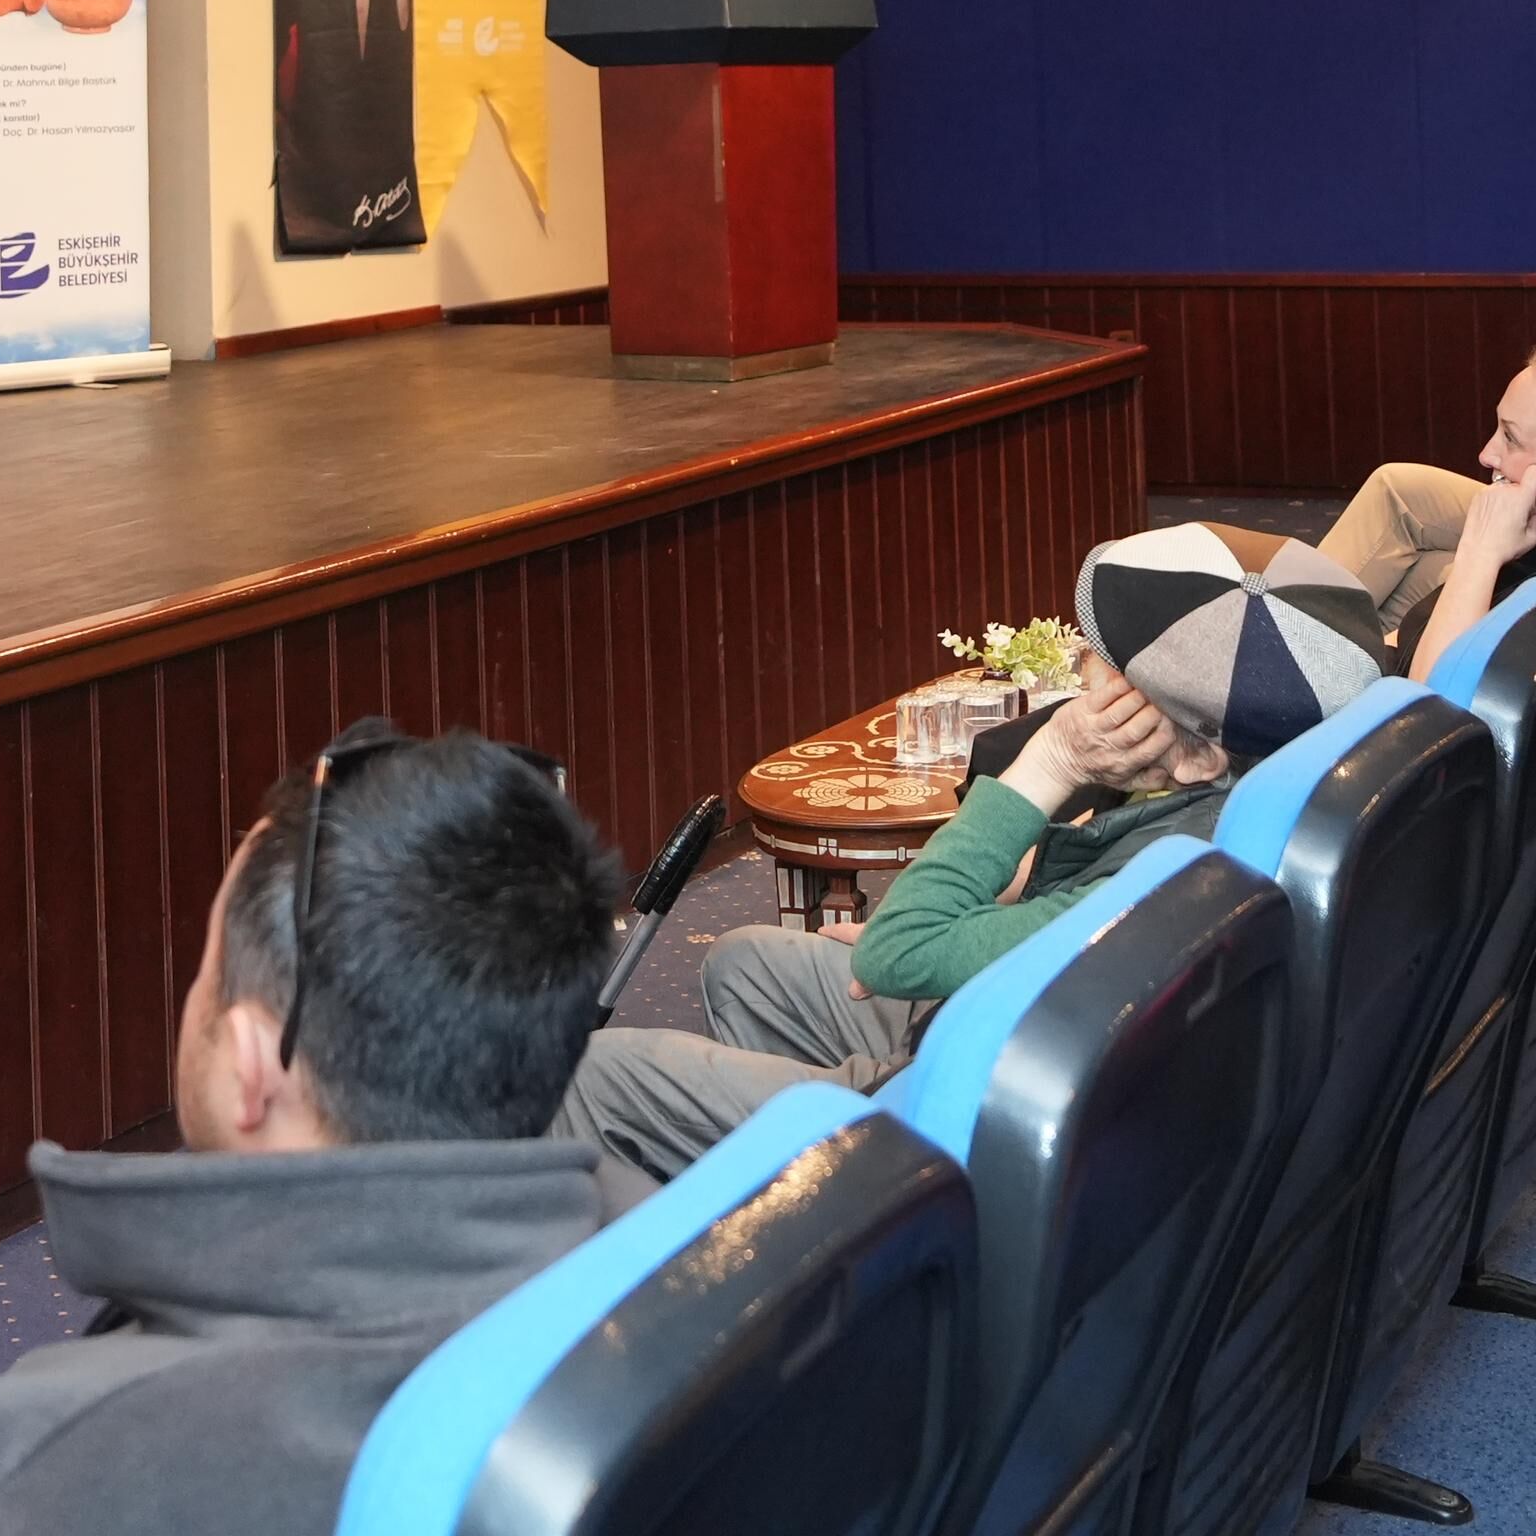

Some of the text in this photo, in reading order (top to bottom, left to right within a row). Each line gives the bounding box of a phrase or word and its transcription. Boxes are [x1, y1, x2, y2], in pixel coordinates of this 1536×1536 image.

[16, 77, 56, 87] Mahmut
[58, 77, 80, 88] Bilge
[41, 126, 74, 136] Hasan
[58, 234, 121, 251] ESKİŞEHİR
[58, 251, 139, 269] BÜYÜKŞEHİR
[58, 268, 128, 287] BELEDİYESİ
